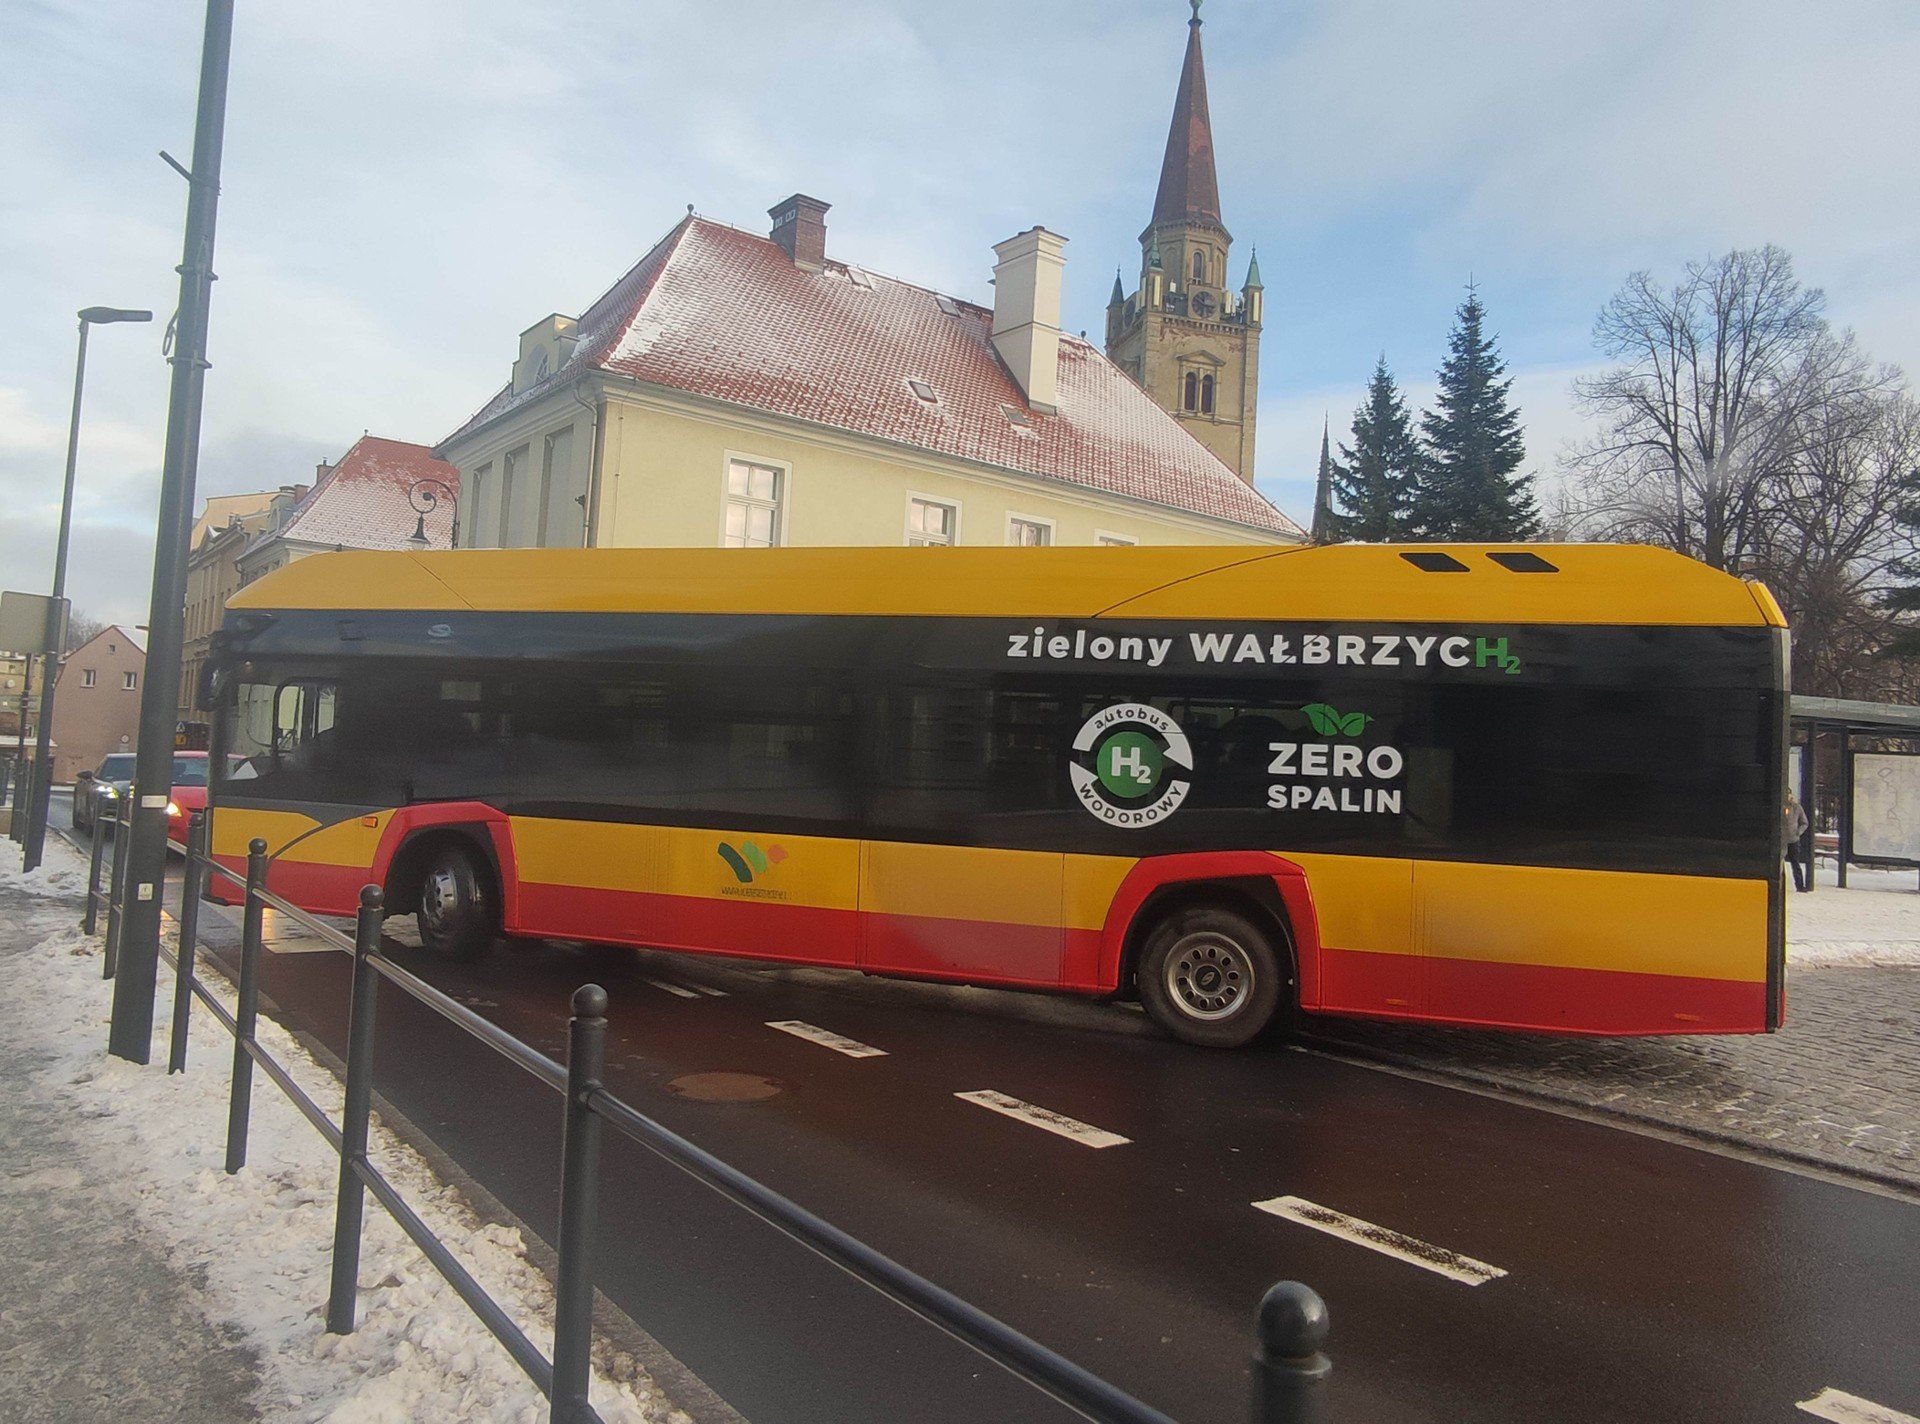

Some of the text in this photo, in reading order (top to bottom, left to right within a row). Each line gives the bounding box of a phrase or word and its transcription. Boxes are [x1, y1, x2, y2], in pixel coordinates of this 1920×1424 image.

[1007, 627, 1172, 667] zielony
[1094, 708, 1169, 730] autobus
[1268, 742, 1403, 779] ZERO
[1080, 783, 1181, 823] WODOROWY
[1267, 784, 1401, 814] SPALIN
